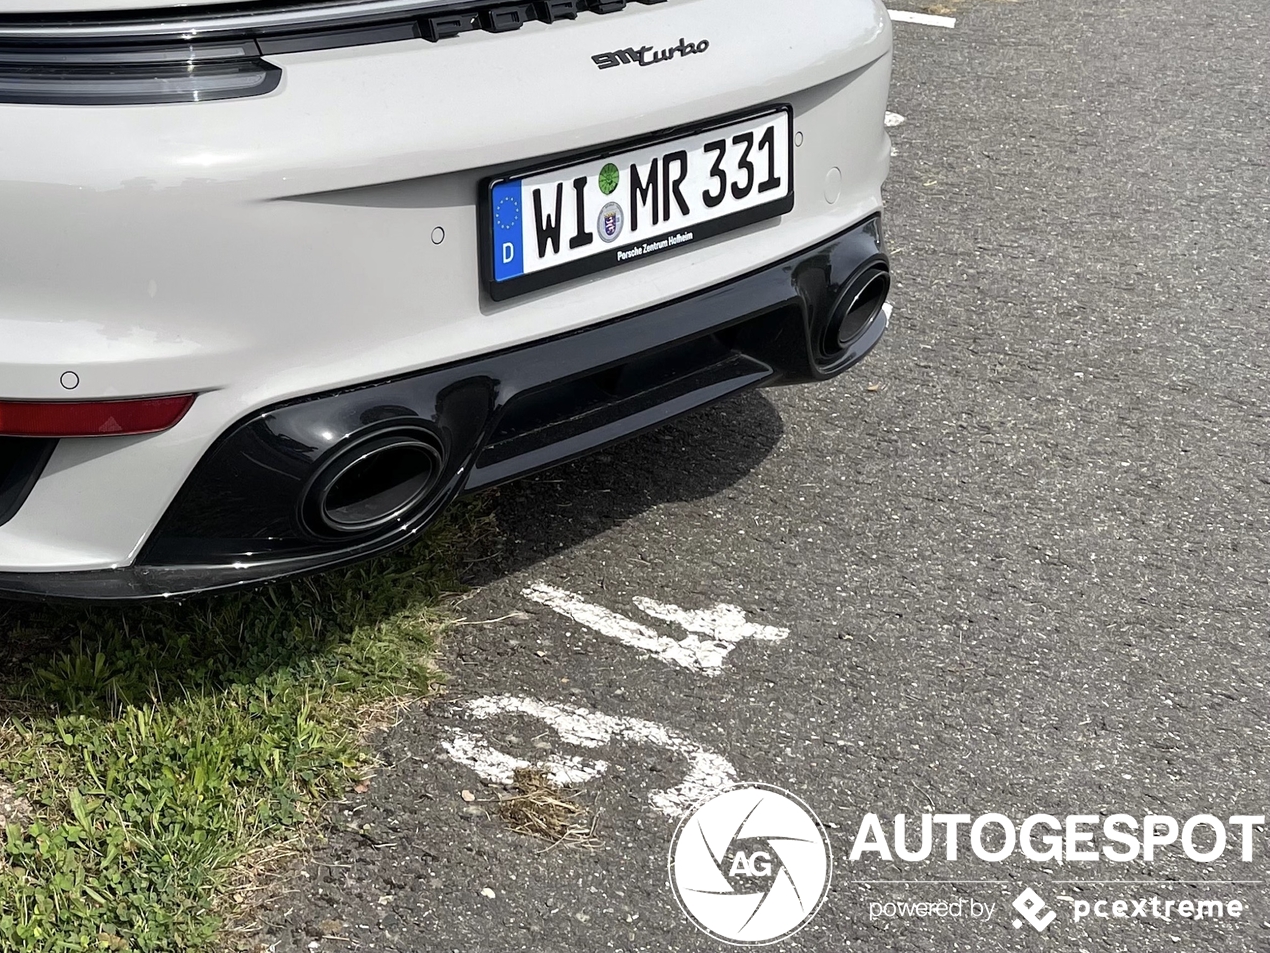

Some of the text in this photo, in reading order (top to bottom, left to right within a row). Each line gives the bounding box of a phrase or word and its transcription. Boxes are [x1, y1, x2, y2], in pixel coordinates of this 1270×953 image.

[532, 126, 781, 259] WI MR 331
[502, 242, 514, 264] D
[616, 232, 693, 261] Porsche Zentrum Hofheim
